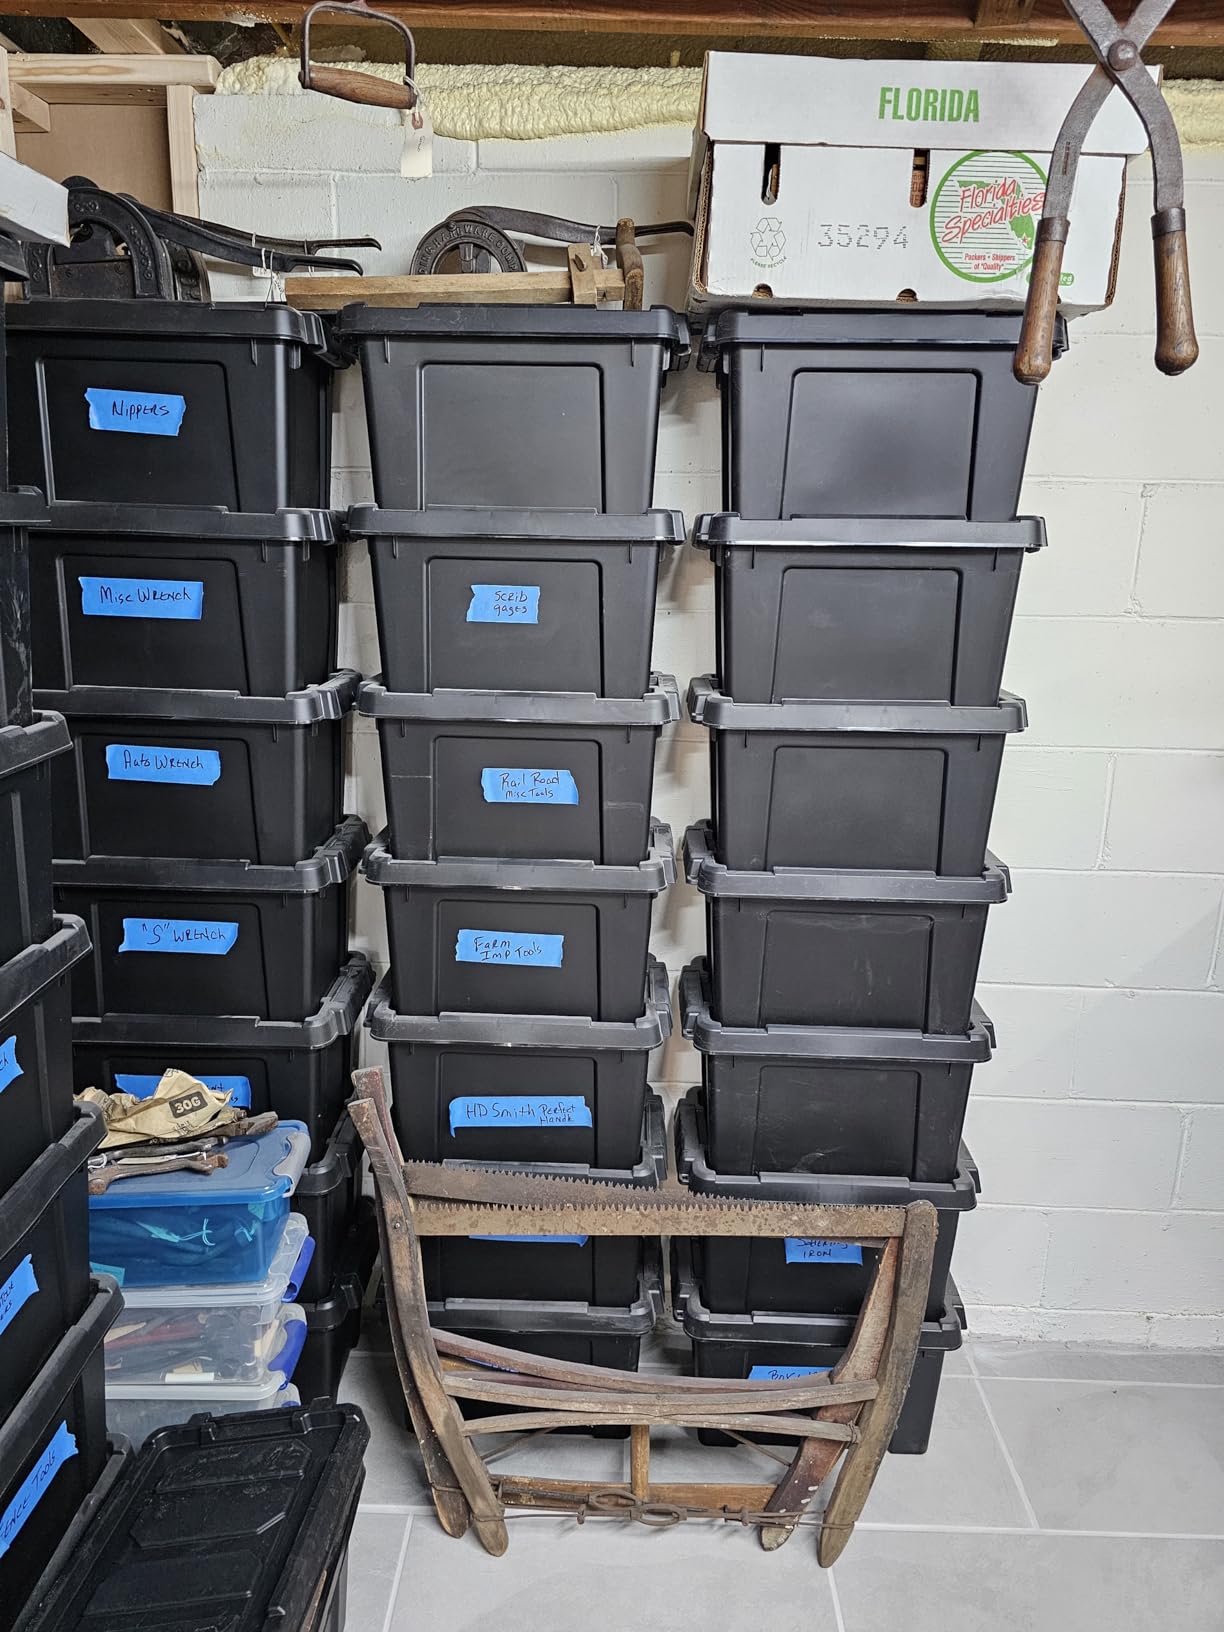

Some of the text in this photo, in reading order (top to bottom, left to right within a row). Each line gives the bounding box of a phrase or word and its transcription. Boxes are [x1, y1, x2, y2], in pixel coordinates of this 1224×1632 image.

[879, 86, 980, 122] FLORIDA
[959, 177, 1017, 213] Florida
[941, 191, 1046, 244] Specialties
[818, 224, 908, 249] 35294
[964, 253, 1016, 263] Packers Shippers
[123, 749, 151, 770] Auto
[530, 770, 560, 787] Road
[174, 1096, 201, 1114] 30G
[491, 1102, 536, 1118] Smith
